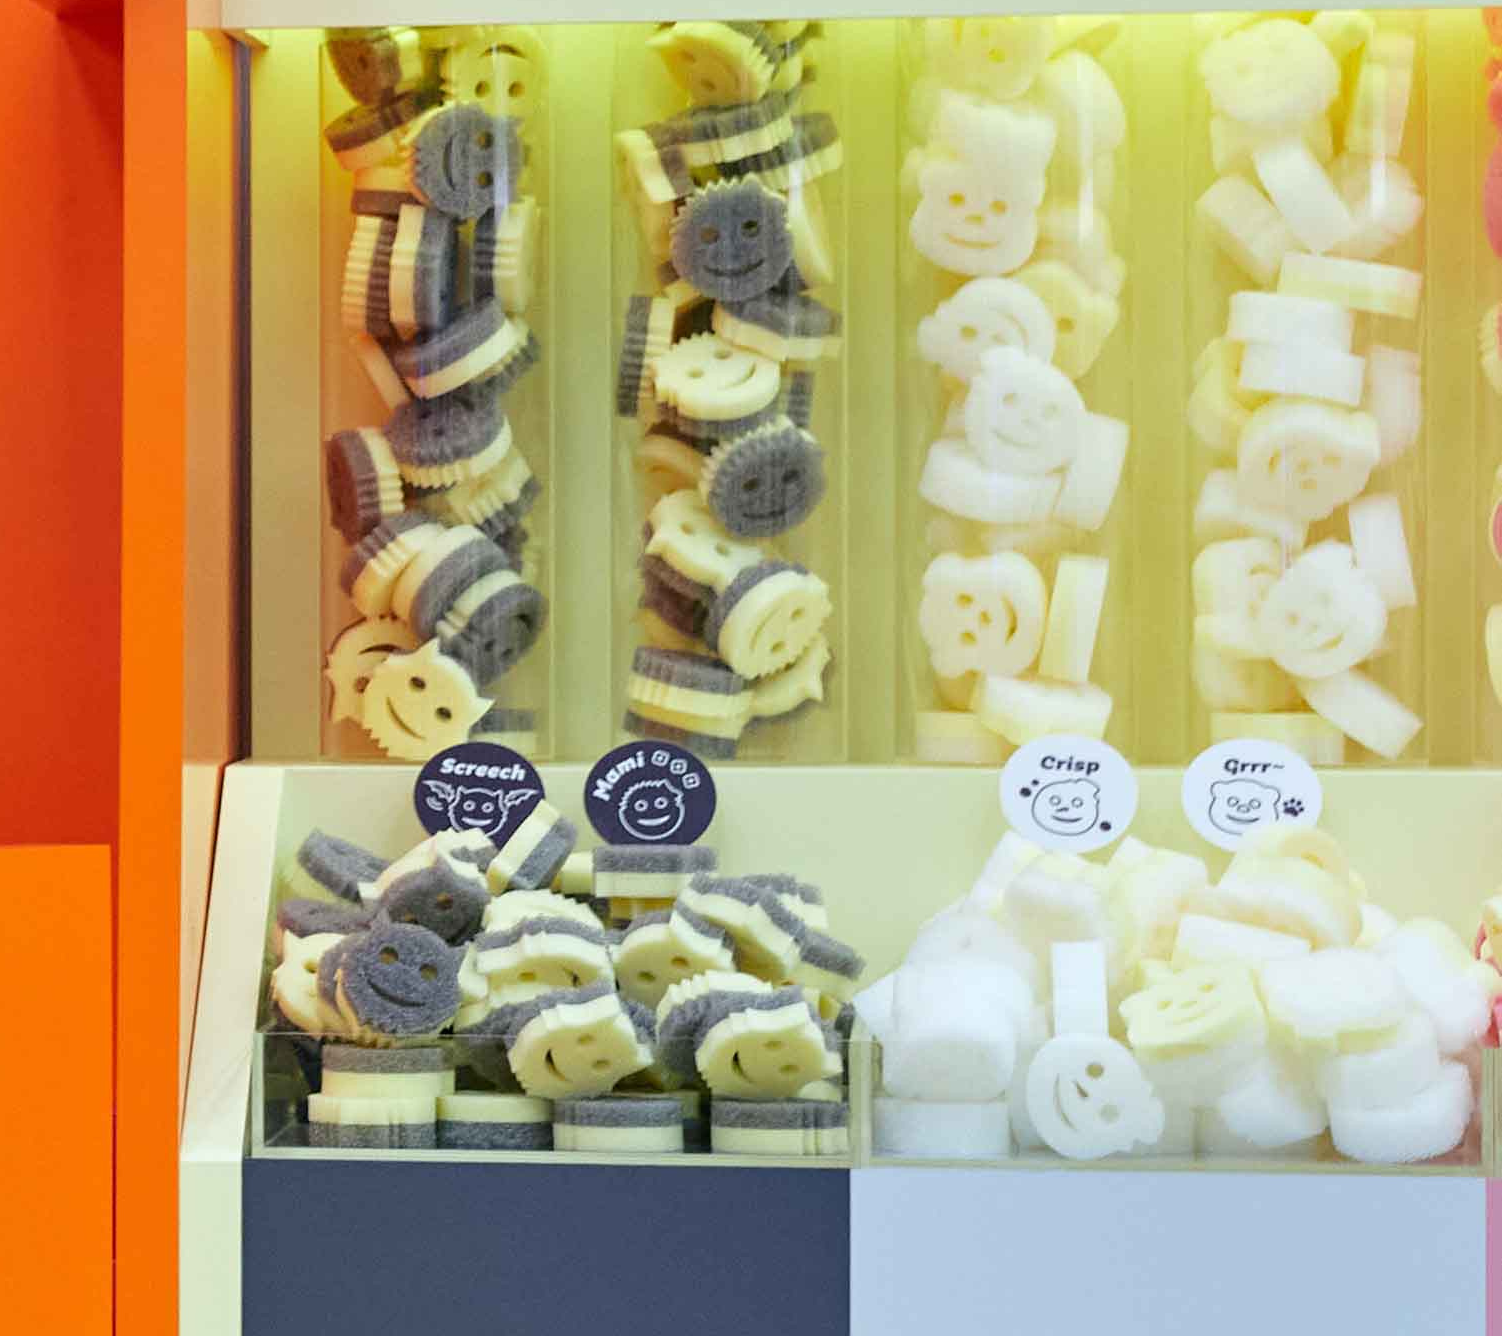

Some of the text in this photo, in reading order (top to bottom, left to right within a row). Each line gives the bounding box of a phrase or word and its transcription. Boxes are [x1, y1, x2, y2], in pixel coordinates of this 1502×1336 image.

[439, 756, 527, 783] Screech
[592, 750, 646, 802] Mami
[1038, 753, 1101, 776] Crisp
